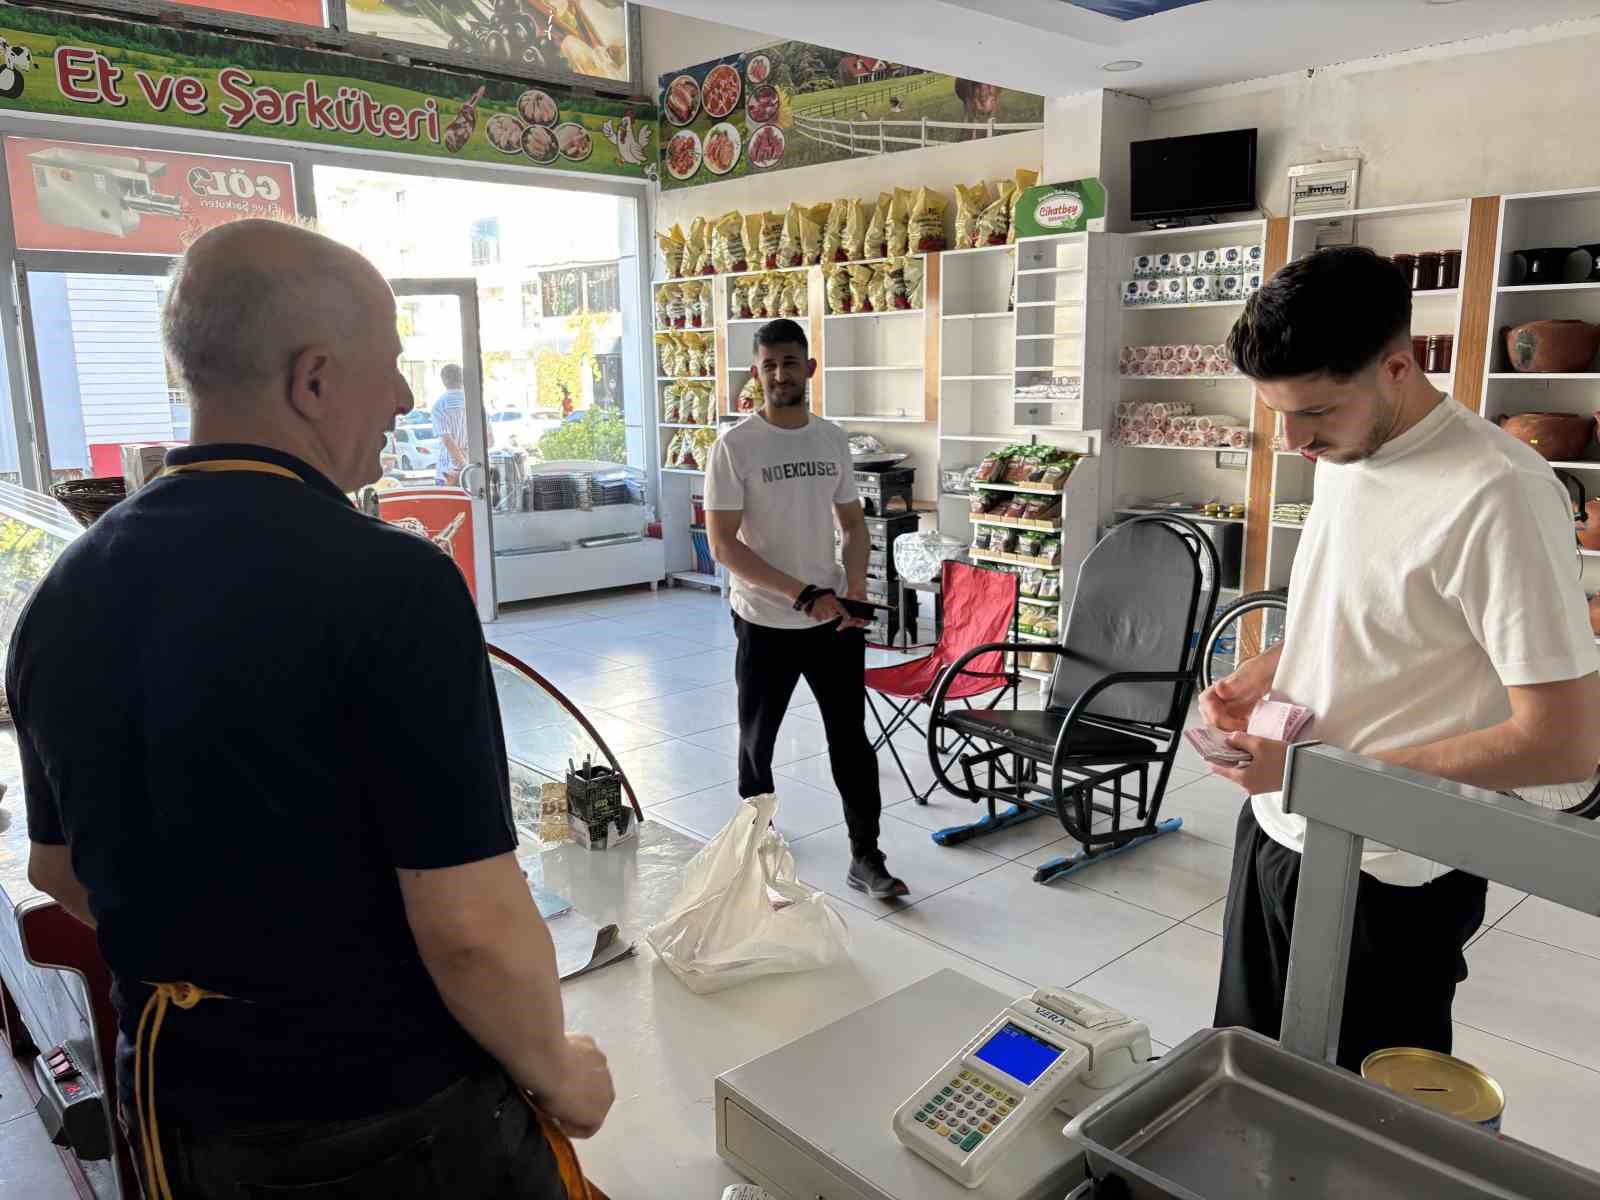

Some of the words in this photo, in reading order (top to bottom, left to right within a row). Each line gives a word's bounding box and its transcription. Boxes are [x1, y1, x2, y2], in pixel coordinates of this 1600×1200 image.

[55, 47, 126, 105] Et
[135, 71, 205, 113] ve
[219, 67, 439, 143] Şarküteri
[1040, 203, 1078, 217] Cihatbey
[1035, 1006, 1066, 1026] VERA
